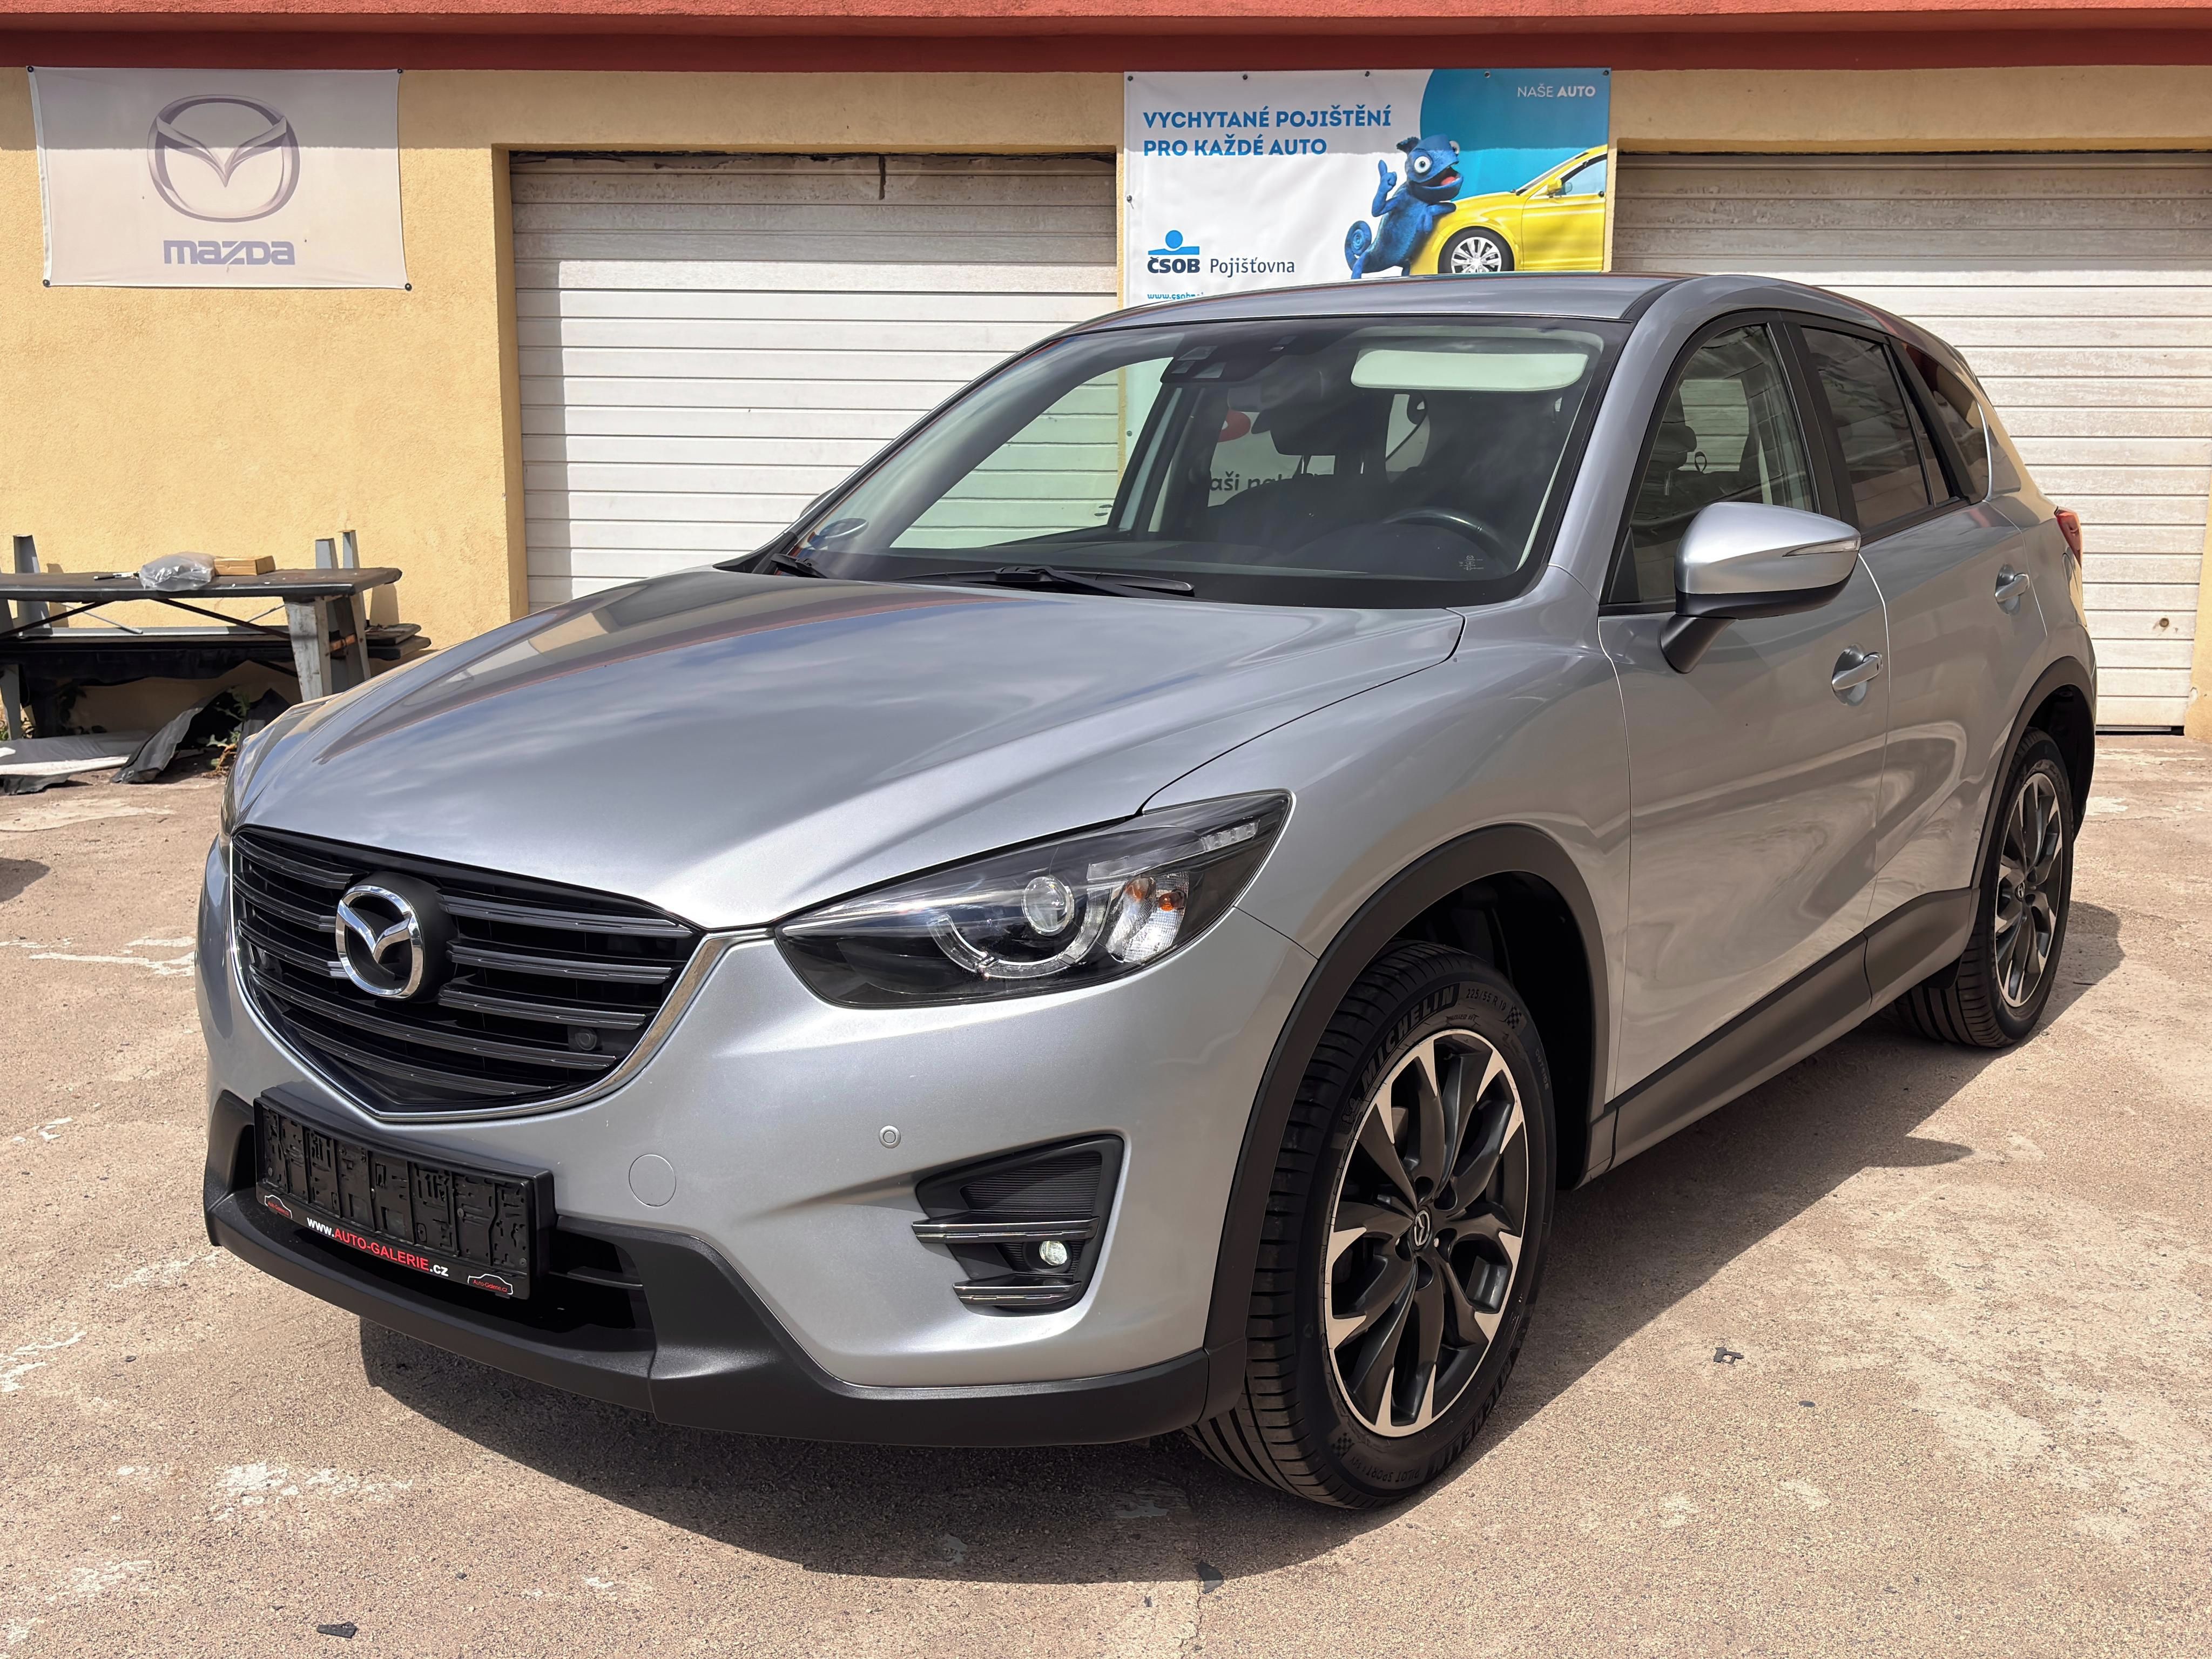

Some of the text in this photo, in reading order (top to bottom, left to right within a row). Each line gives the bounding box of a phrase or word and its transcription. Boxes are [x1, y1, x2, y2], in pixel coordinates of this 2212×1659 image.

[1517, 83, 1596, 98] NAŠE AUTO
[1143, 104, 1392, 128] VYCHYTANÉ POJIŠTĚNÍ
[1144, 133, 1327, 156] PRO KAŽDÉ AUTO
[1147, 257, 1295, 278] ČSOB Pojišťovna
[1210, 471, 1240, 491] aši
[1466, 988, 1492, 1003] 225/55
[1361, 986, 1455, 1094] MICHELIN
[307, 1217, 449, 1277] www.AUTO-GALERIE.cz
